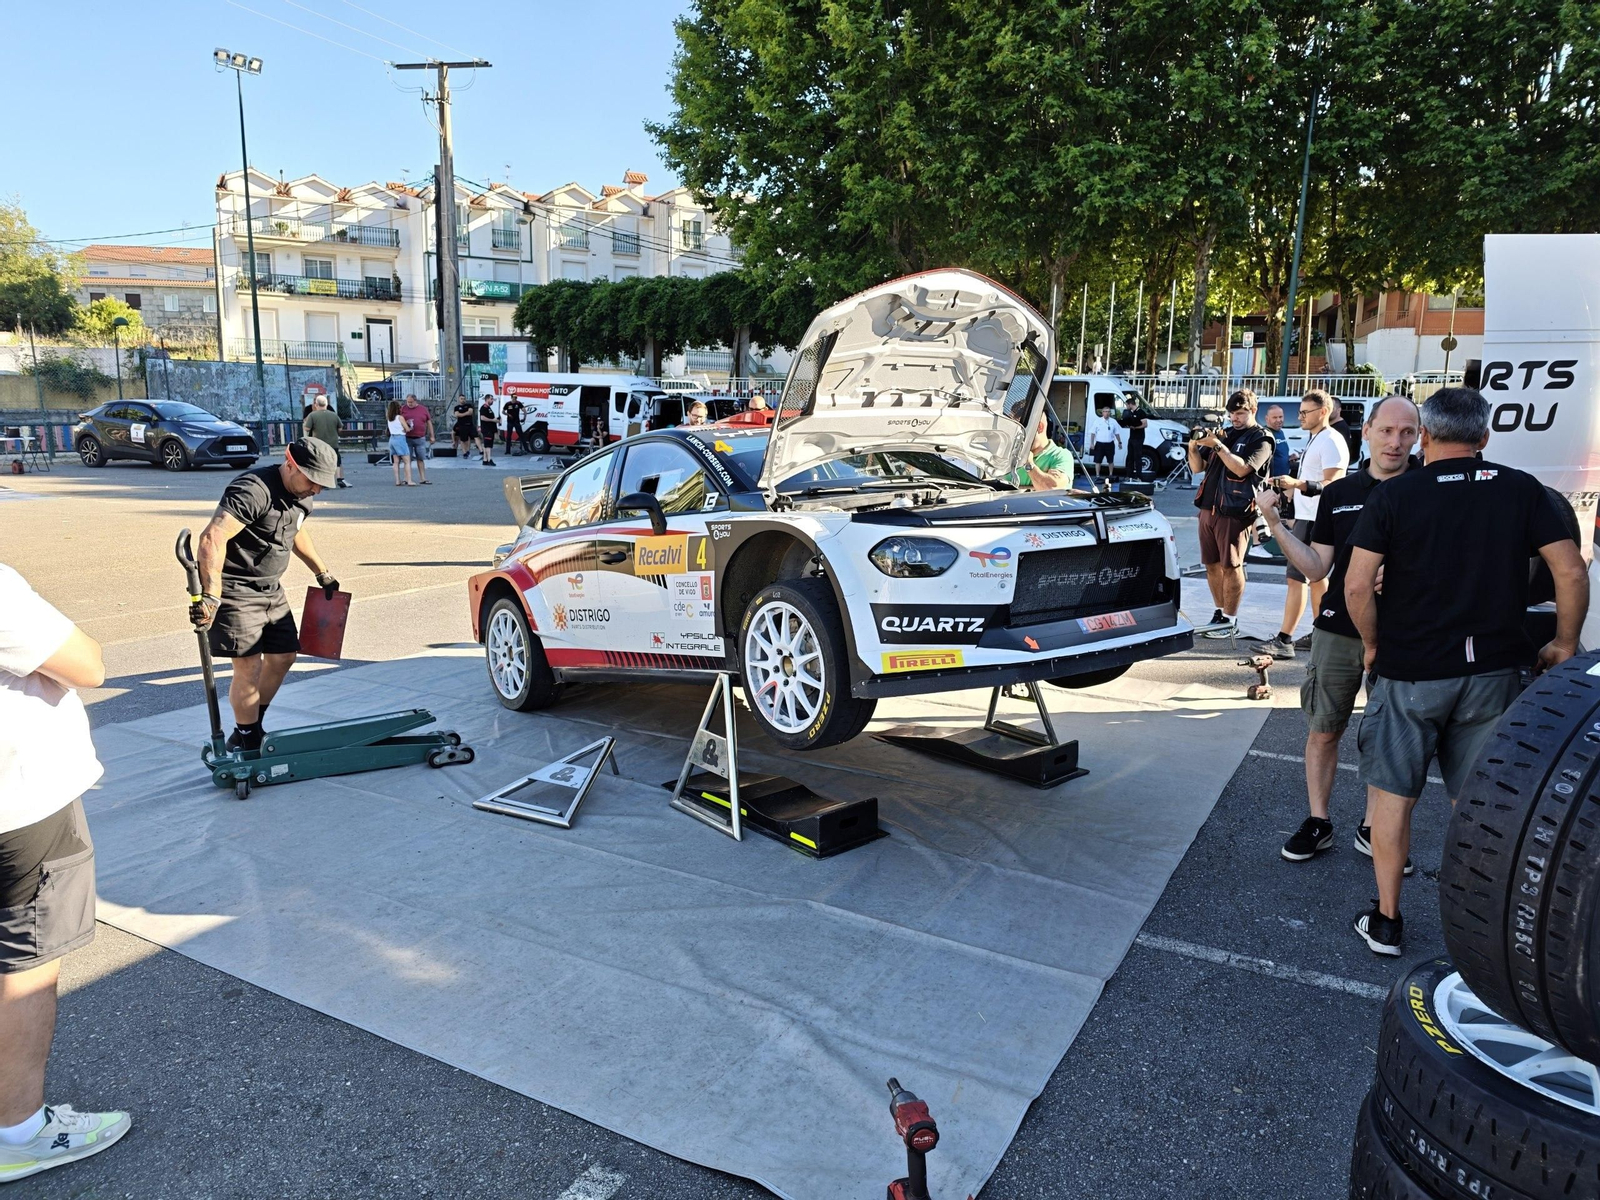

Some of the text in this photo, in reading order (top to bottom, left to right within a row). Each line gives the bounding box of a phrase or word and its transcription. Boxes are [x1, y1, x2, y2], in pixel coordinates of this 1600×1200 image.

[1480, 359, 1578, 391] RTS
[1489, 402, 1558, 432] OU
[1041, 530, 1086, 540] DISTRIGO
[1118, 523, 1153, 532] DISTRIGO
[638, 545, 682, 565] Recalvi
[696, 537, 707, 569] 4
[569, 609, 611, 622] DISTRIGO
[881, 616, 985, 633] QUARTZ
[666, 643, 721, 651] INTEGRALE
[889, 653, 956, 669] PIRELLI
